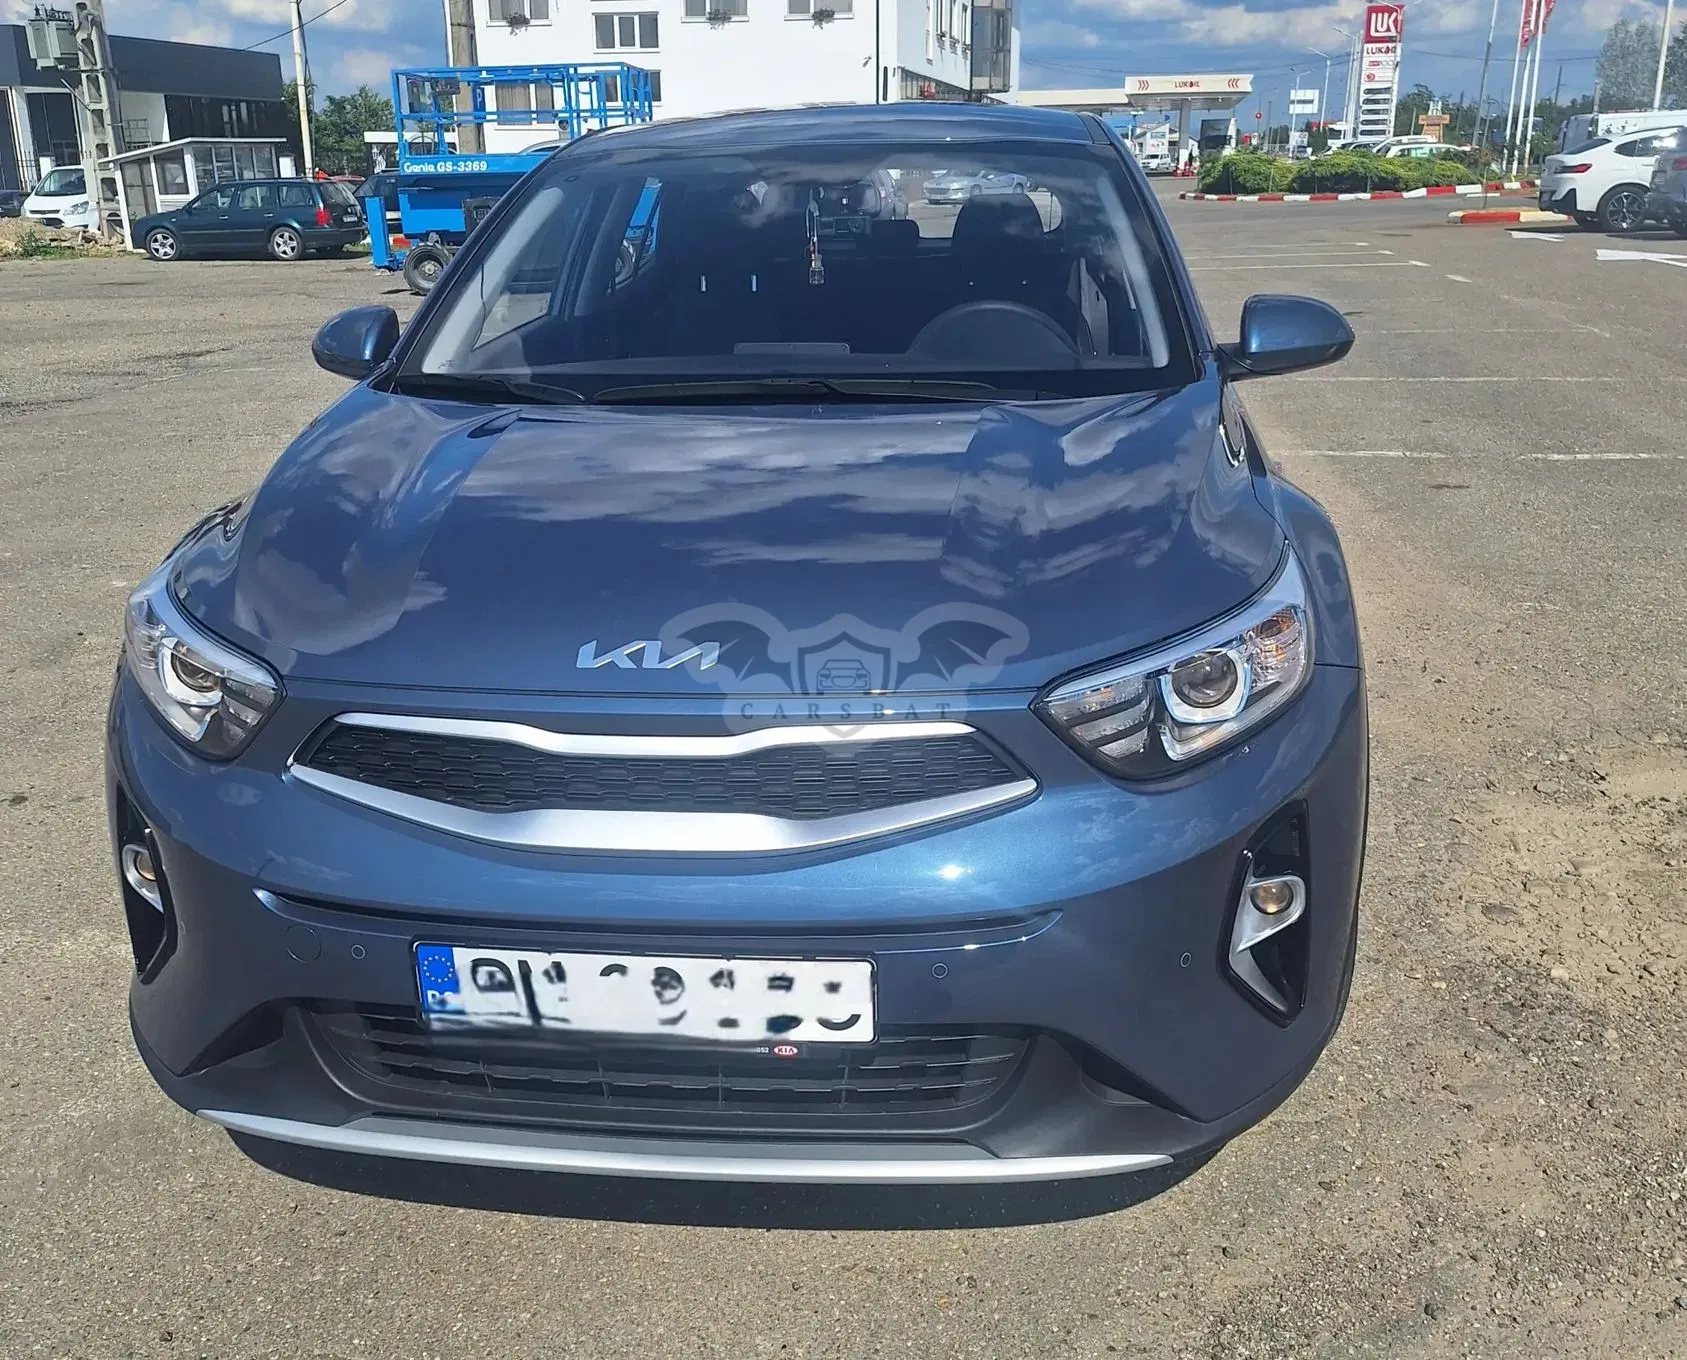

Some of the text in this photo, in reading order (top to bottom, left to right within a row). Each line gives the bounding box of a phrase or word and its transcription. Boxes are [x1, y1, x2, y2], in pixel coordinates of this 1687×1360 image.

[1174, 80, 1200, 88] LUKOIL
[403, 160, 488, 173] Genie GS-3369
